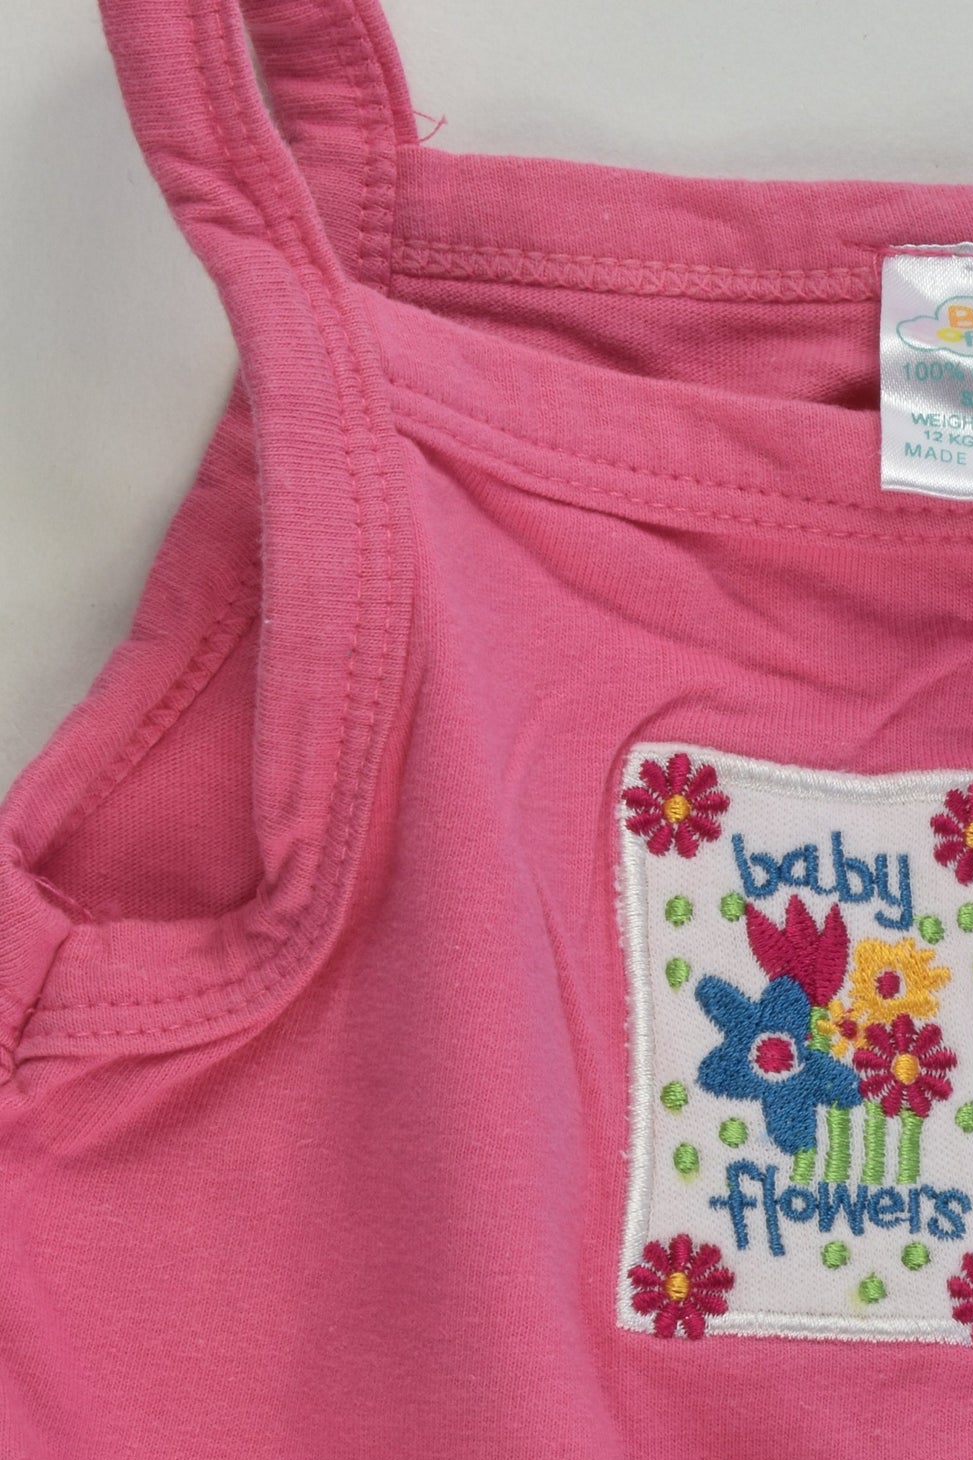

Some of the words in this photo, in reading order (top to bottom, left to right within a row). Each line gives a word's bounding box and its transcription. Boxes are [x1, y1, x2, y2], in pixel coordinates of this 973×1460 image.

[903, 361, 965, 382] 100%
[924, 430, 943, 442] 12
[904, 442, 967, 465] MADE
[732, 831, 914, 931] baby
[710, 1159, 972, 1257] flowers
